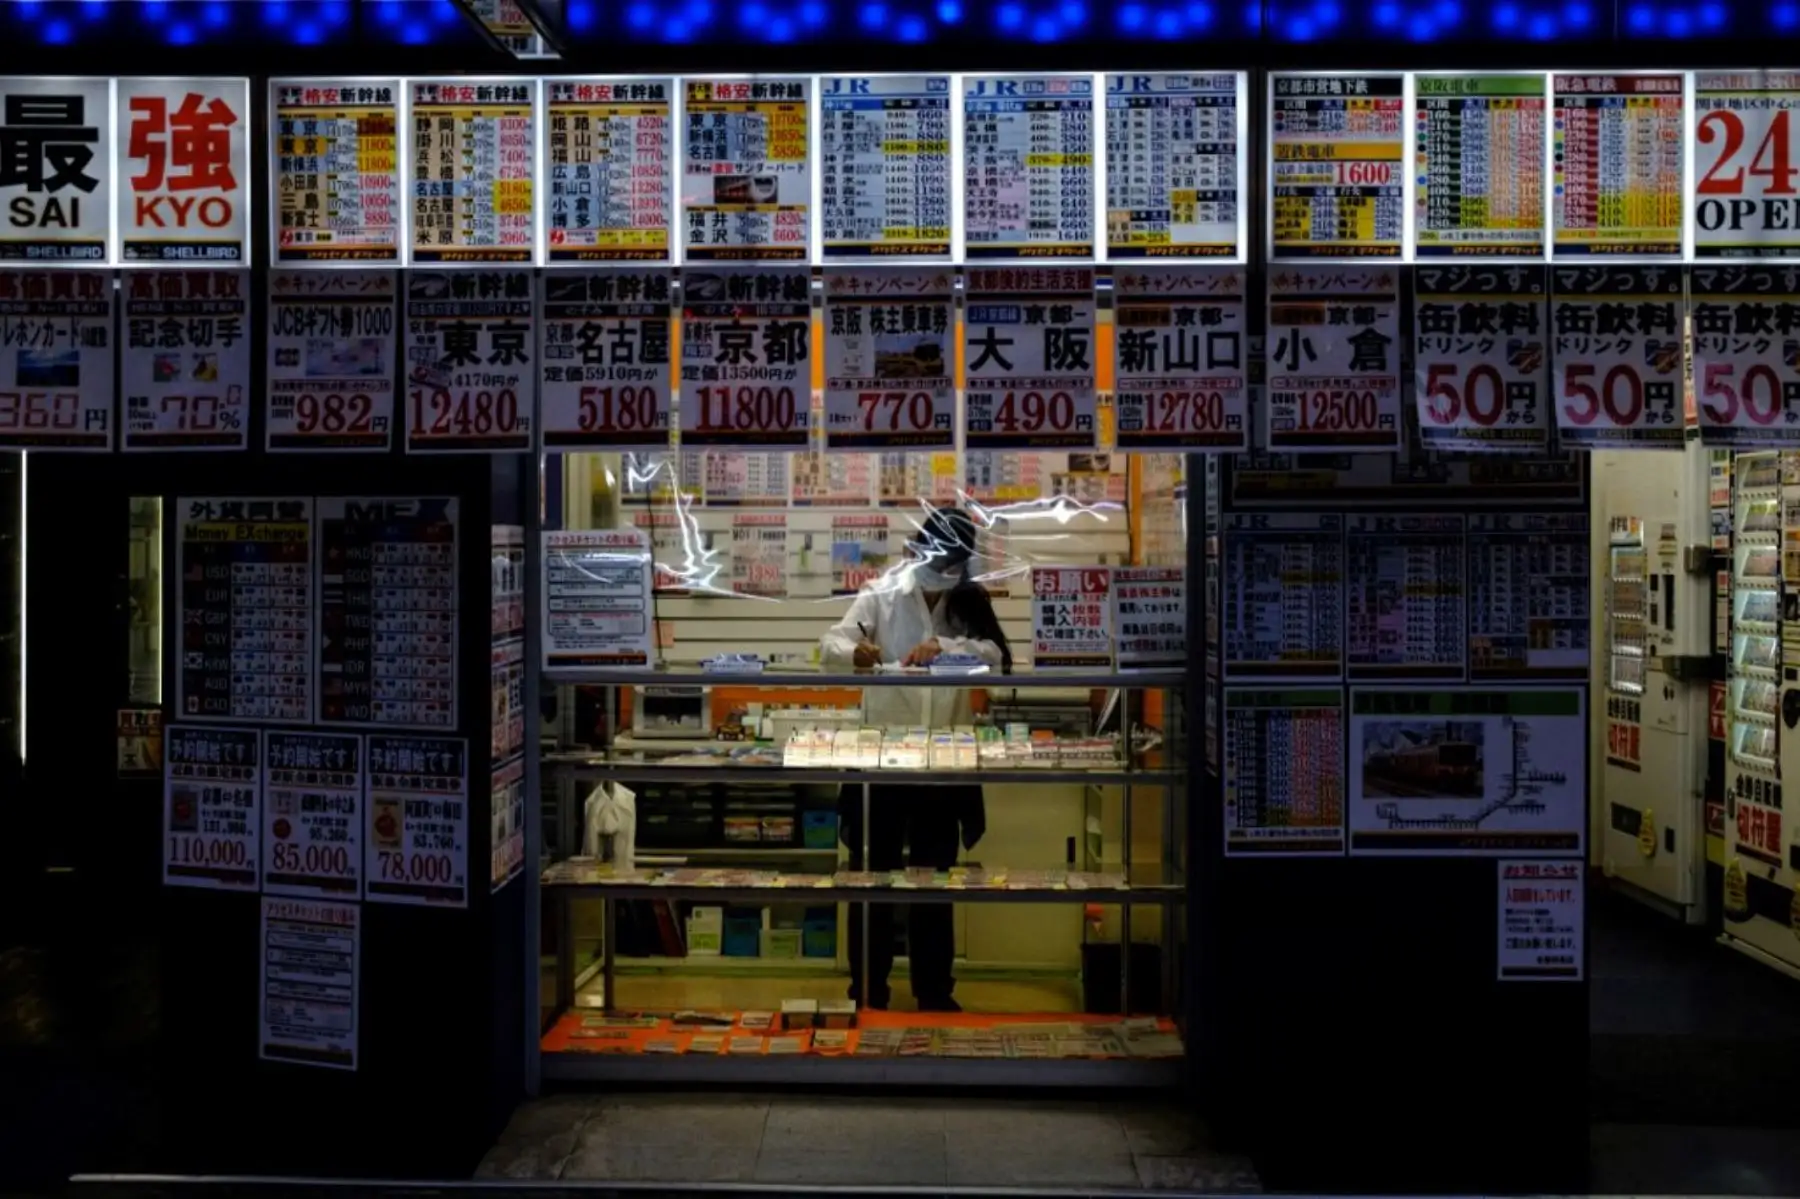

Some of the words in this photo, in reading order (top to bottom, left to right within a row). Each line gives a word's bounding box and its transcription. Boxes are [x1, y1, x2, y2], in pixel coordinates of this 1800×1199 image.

[578, 84, 664, 100] 格安新幹線
[717, 83, 802, 99] 格安新幹線
[825, 79, 869, 94] JR
[967, 80, 1018, 96] JR
[1109, 76, 1151, 91] JR
[1276, 78, 1369, 95] 京都市営地下鉄
[305, 87, 391, 103] 格安新幹線
[442, 86, 528, 101] 格安新幹線
[0, 95, 98, 193] 最
[129, 93, 237, 192] 強
[1697, 110, 1798, 194] 24
[281, 174, 318, 190] 小田原
[416, 182, 454, 197] 名古屋
[10, 197, 79, 228] SAI
[136, 197, 232, 228] KYO
[416, 198, 454, 213] 名古屋
[690, 213, 727, 227] 福井
[690, 229, 727, 243] 金沢
[129, 272, 239, 298] 高価買取
[293, 275, 372, 292] キャンペーン
[451, 273, 530, 299] 新幹線
[589, 274, 669, 300] 新幹線
[728, 274, 808, 300] 新幹線
[847, 276, 931, 293] キャンペーン
[1138, 274, 1219, 290] キャンペーン
[1291, 274, 1375, 290] キャンペーン
[831, 305, 862, 335] 京阪
[870, 305, 948, 335] 株主乗車券
[1417, 302, 1539, 335] 缶飲料
[1555, 302, 1677, 335] 缶飲料
[130, 317, 242, 348] 記念切手
[438, 320, 530, 366] 東京
[576, 321, 668, 364] 名古屋
[715, 321, 807, 364] 京都
[968, 327, 1091, 371] 大阪
[1119, 329, 1240, 372] 新山口
[1273, 328, 1392, 372] 小倉
[1418, 337, 1495, 354] ドリンク
[1556, 337, 1633, 354] ドリンク
[1695, 336, 1771, 354] ドリンク
[1505, 411, 1536, 424] から
[1645, 411, 1675, 424] から
[184, 523, 230, 541] Money
[1033, 570, 1109, 592] お願い
